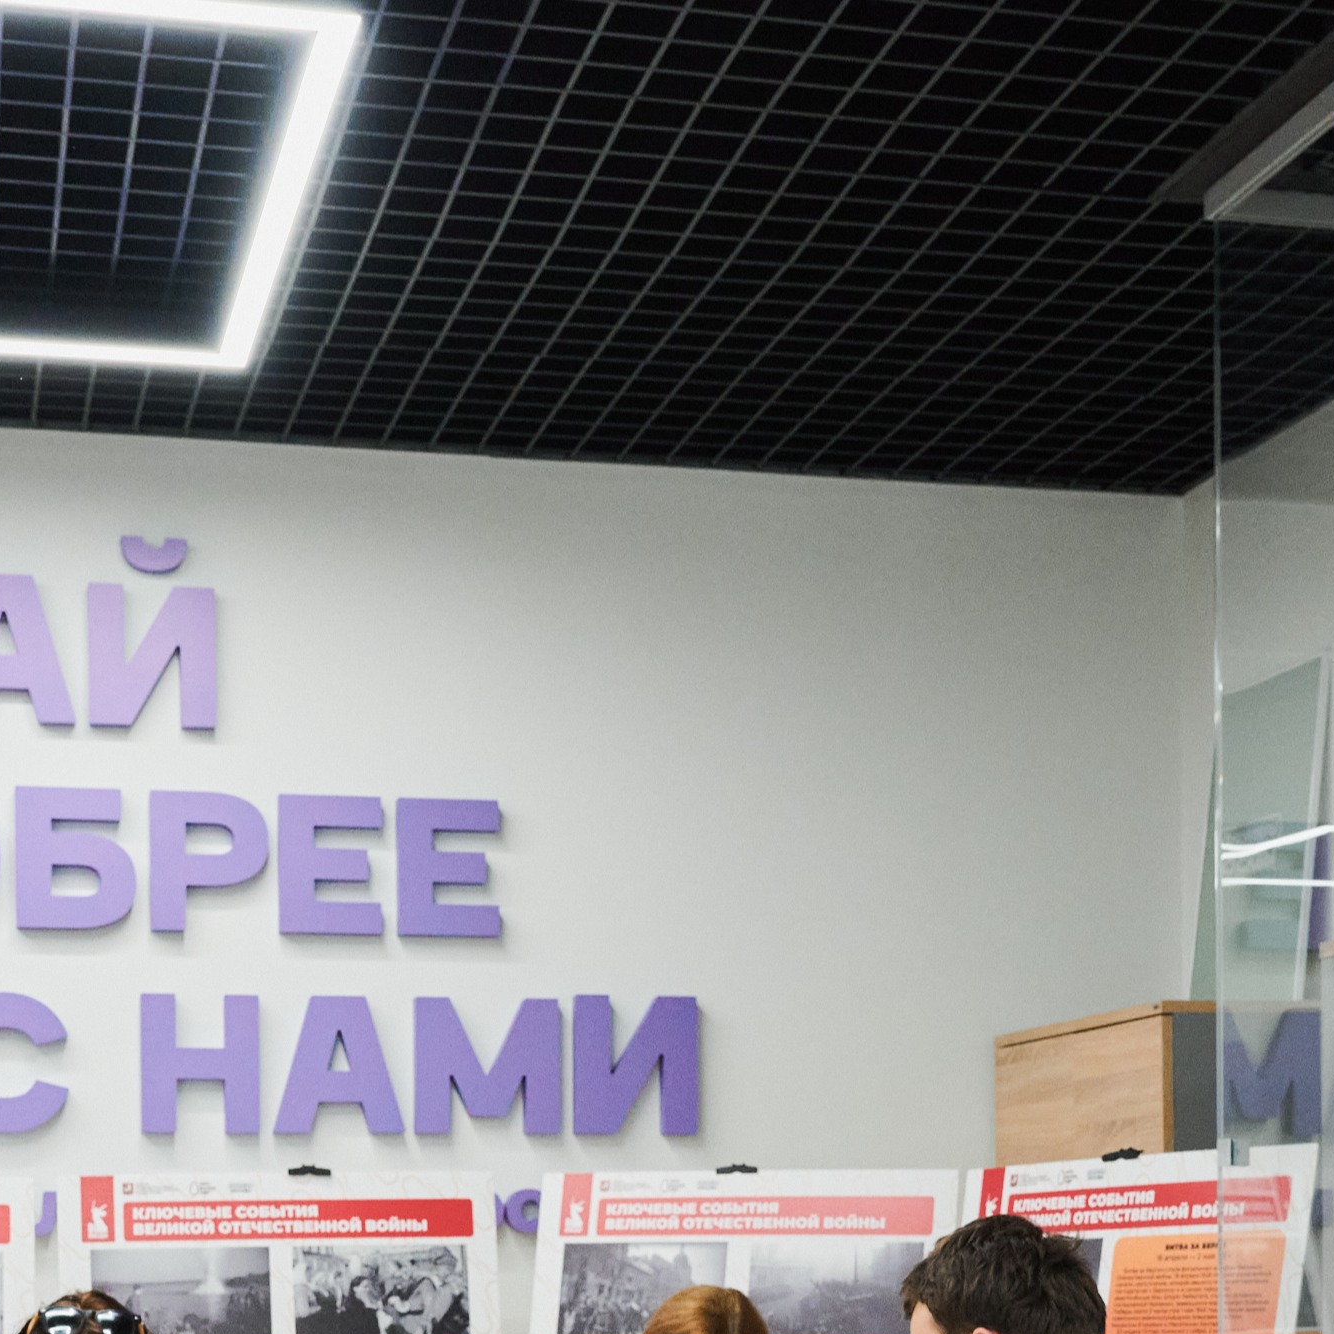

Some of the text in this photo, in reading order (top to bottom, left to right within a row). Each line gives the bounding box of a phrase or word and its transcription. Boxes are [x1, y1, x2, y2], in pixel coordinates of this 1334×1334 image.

[140, 993, 700, 1137] НАМИ
[132, 1204, 319, 1220] КЛЮЧЕВЫЕ СОБЫТИЯ
[604, 1201, 780, 1217] КЛЮЧЕВЫЕ СОБЫТИЯ
[1013, 1190, 1155, 1213] КЛЮЧЕВЫЕ СОБЫТИЯ
[132, 1214, 428, 1236] ВЕЛИКОЙ ОТЕЧЕСТВЕННОЙ ВОЙНЫ
[604, 1211, 886, 1231] ВЕЛИКОЙ ОТЕЧЕСТВЕННОЙ ВОЙНЫ
[1028, 1200, 1244, 1228] ЛИКОЙ ОТЕЧЕСТВЕННОЙ ВОЙНЫ
